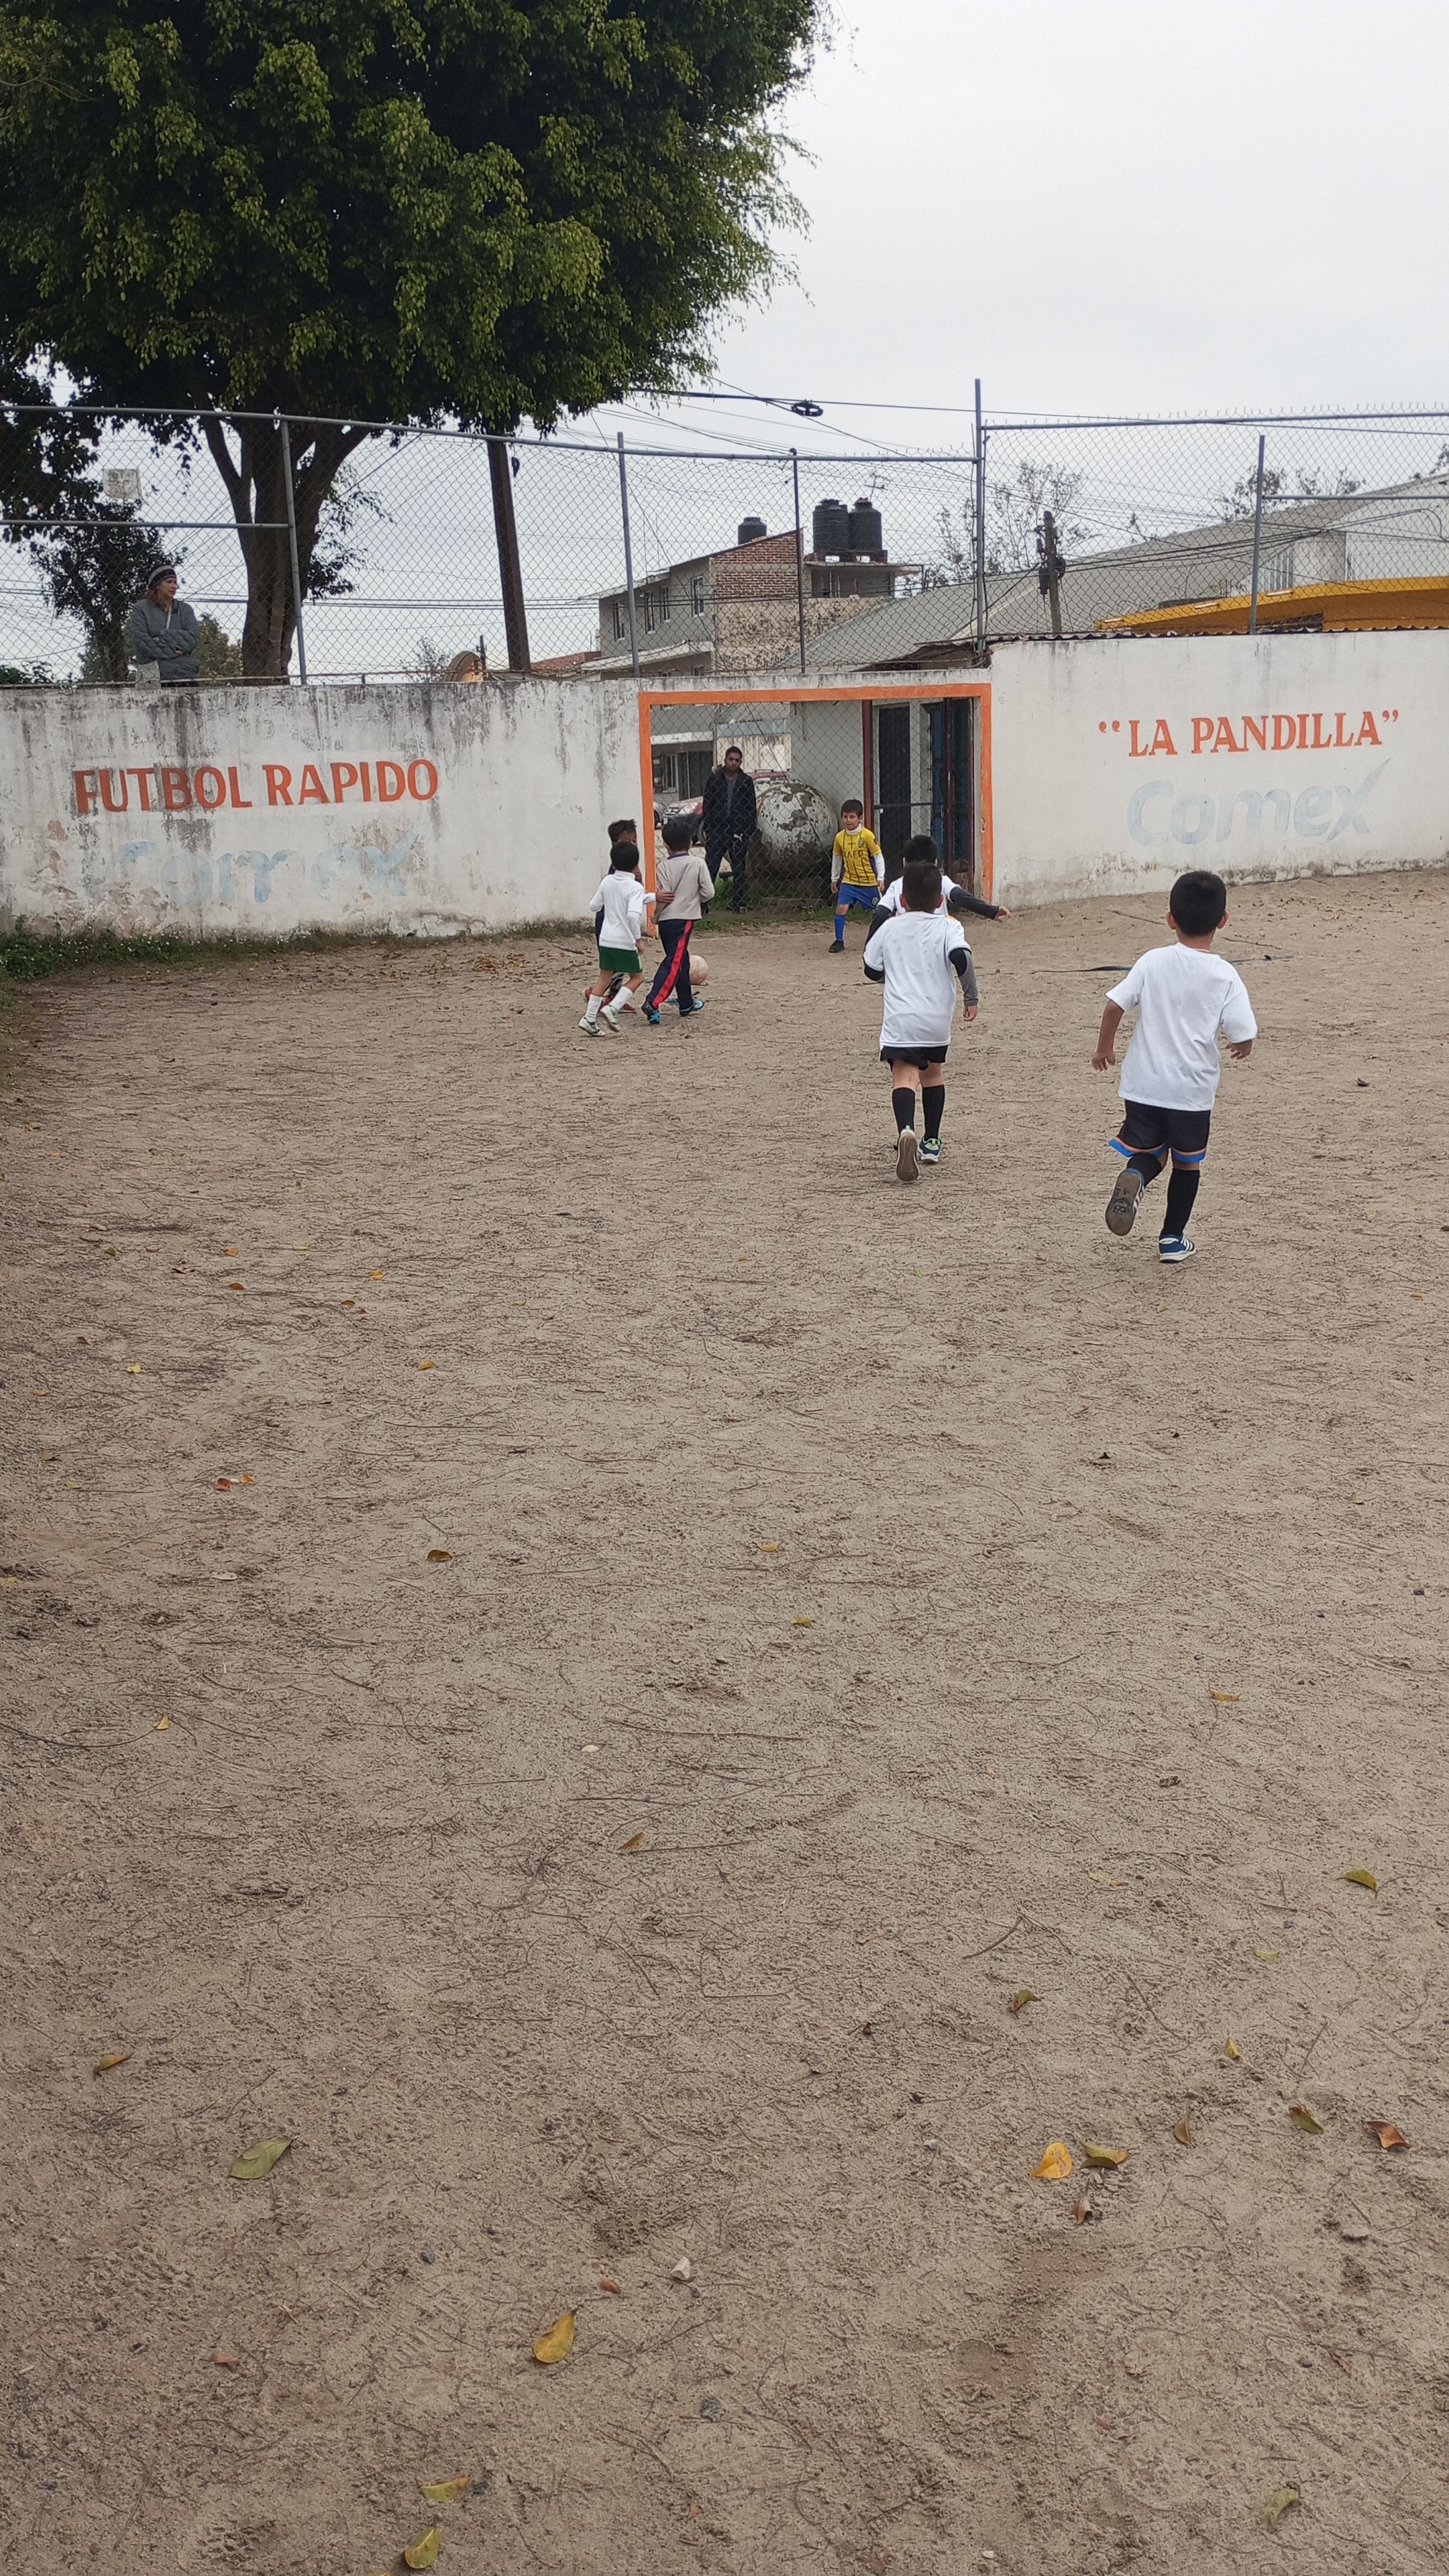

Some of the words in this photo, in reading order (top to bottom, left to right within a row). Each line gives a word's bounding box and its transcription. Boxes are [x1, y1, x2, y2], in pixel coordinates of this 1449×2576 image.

[1191, 709, 1399, 754] PANDILLA"
[72, 767, 252, 813] FUTBOL
[262, 759, 438, 806] RAPIDO
[1127, 756, 1392, 846] Comex
